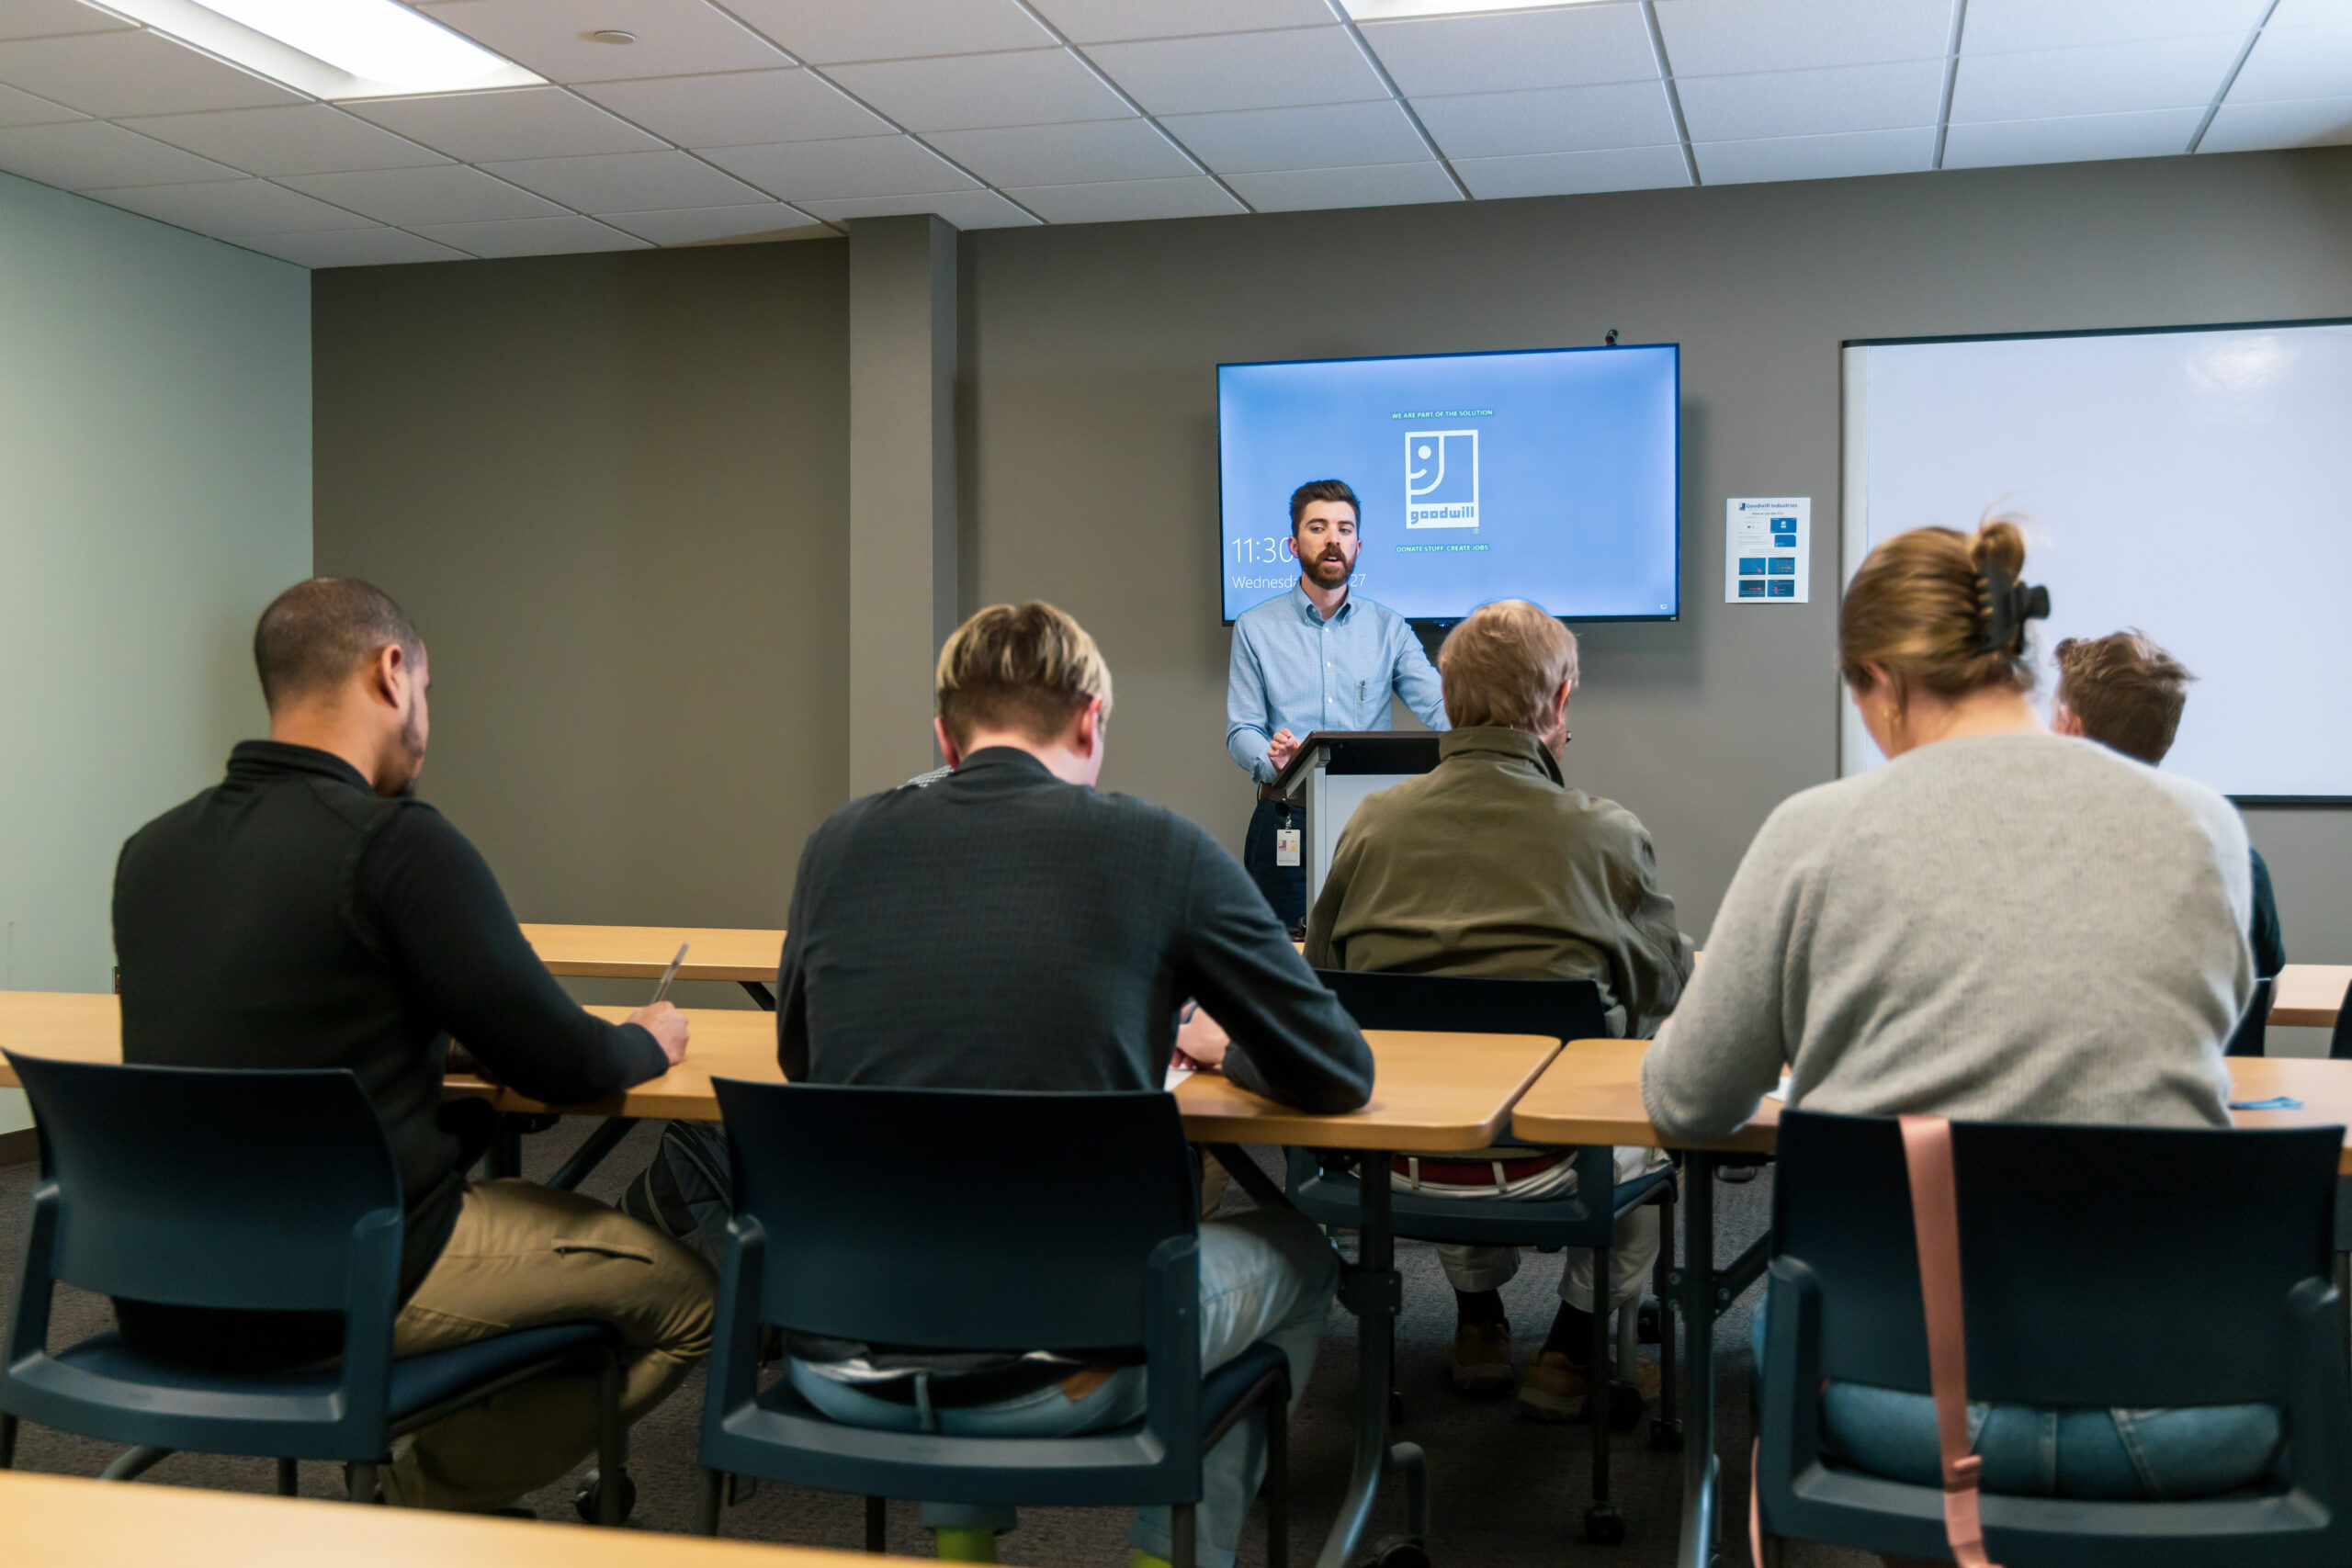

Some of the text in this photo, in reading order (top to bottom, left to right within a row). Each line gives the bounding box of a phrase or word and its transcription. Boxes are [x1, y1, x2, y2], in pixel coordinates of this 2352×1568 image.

[1410, 506, 1475, 525] goodwill
[1232, 537, 1294, 563] 11:30
[1350, 573, 1366, 588] 27
